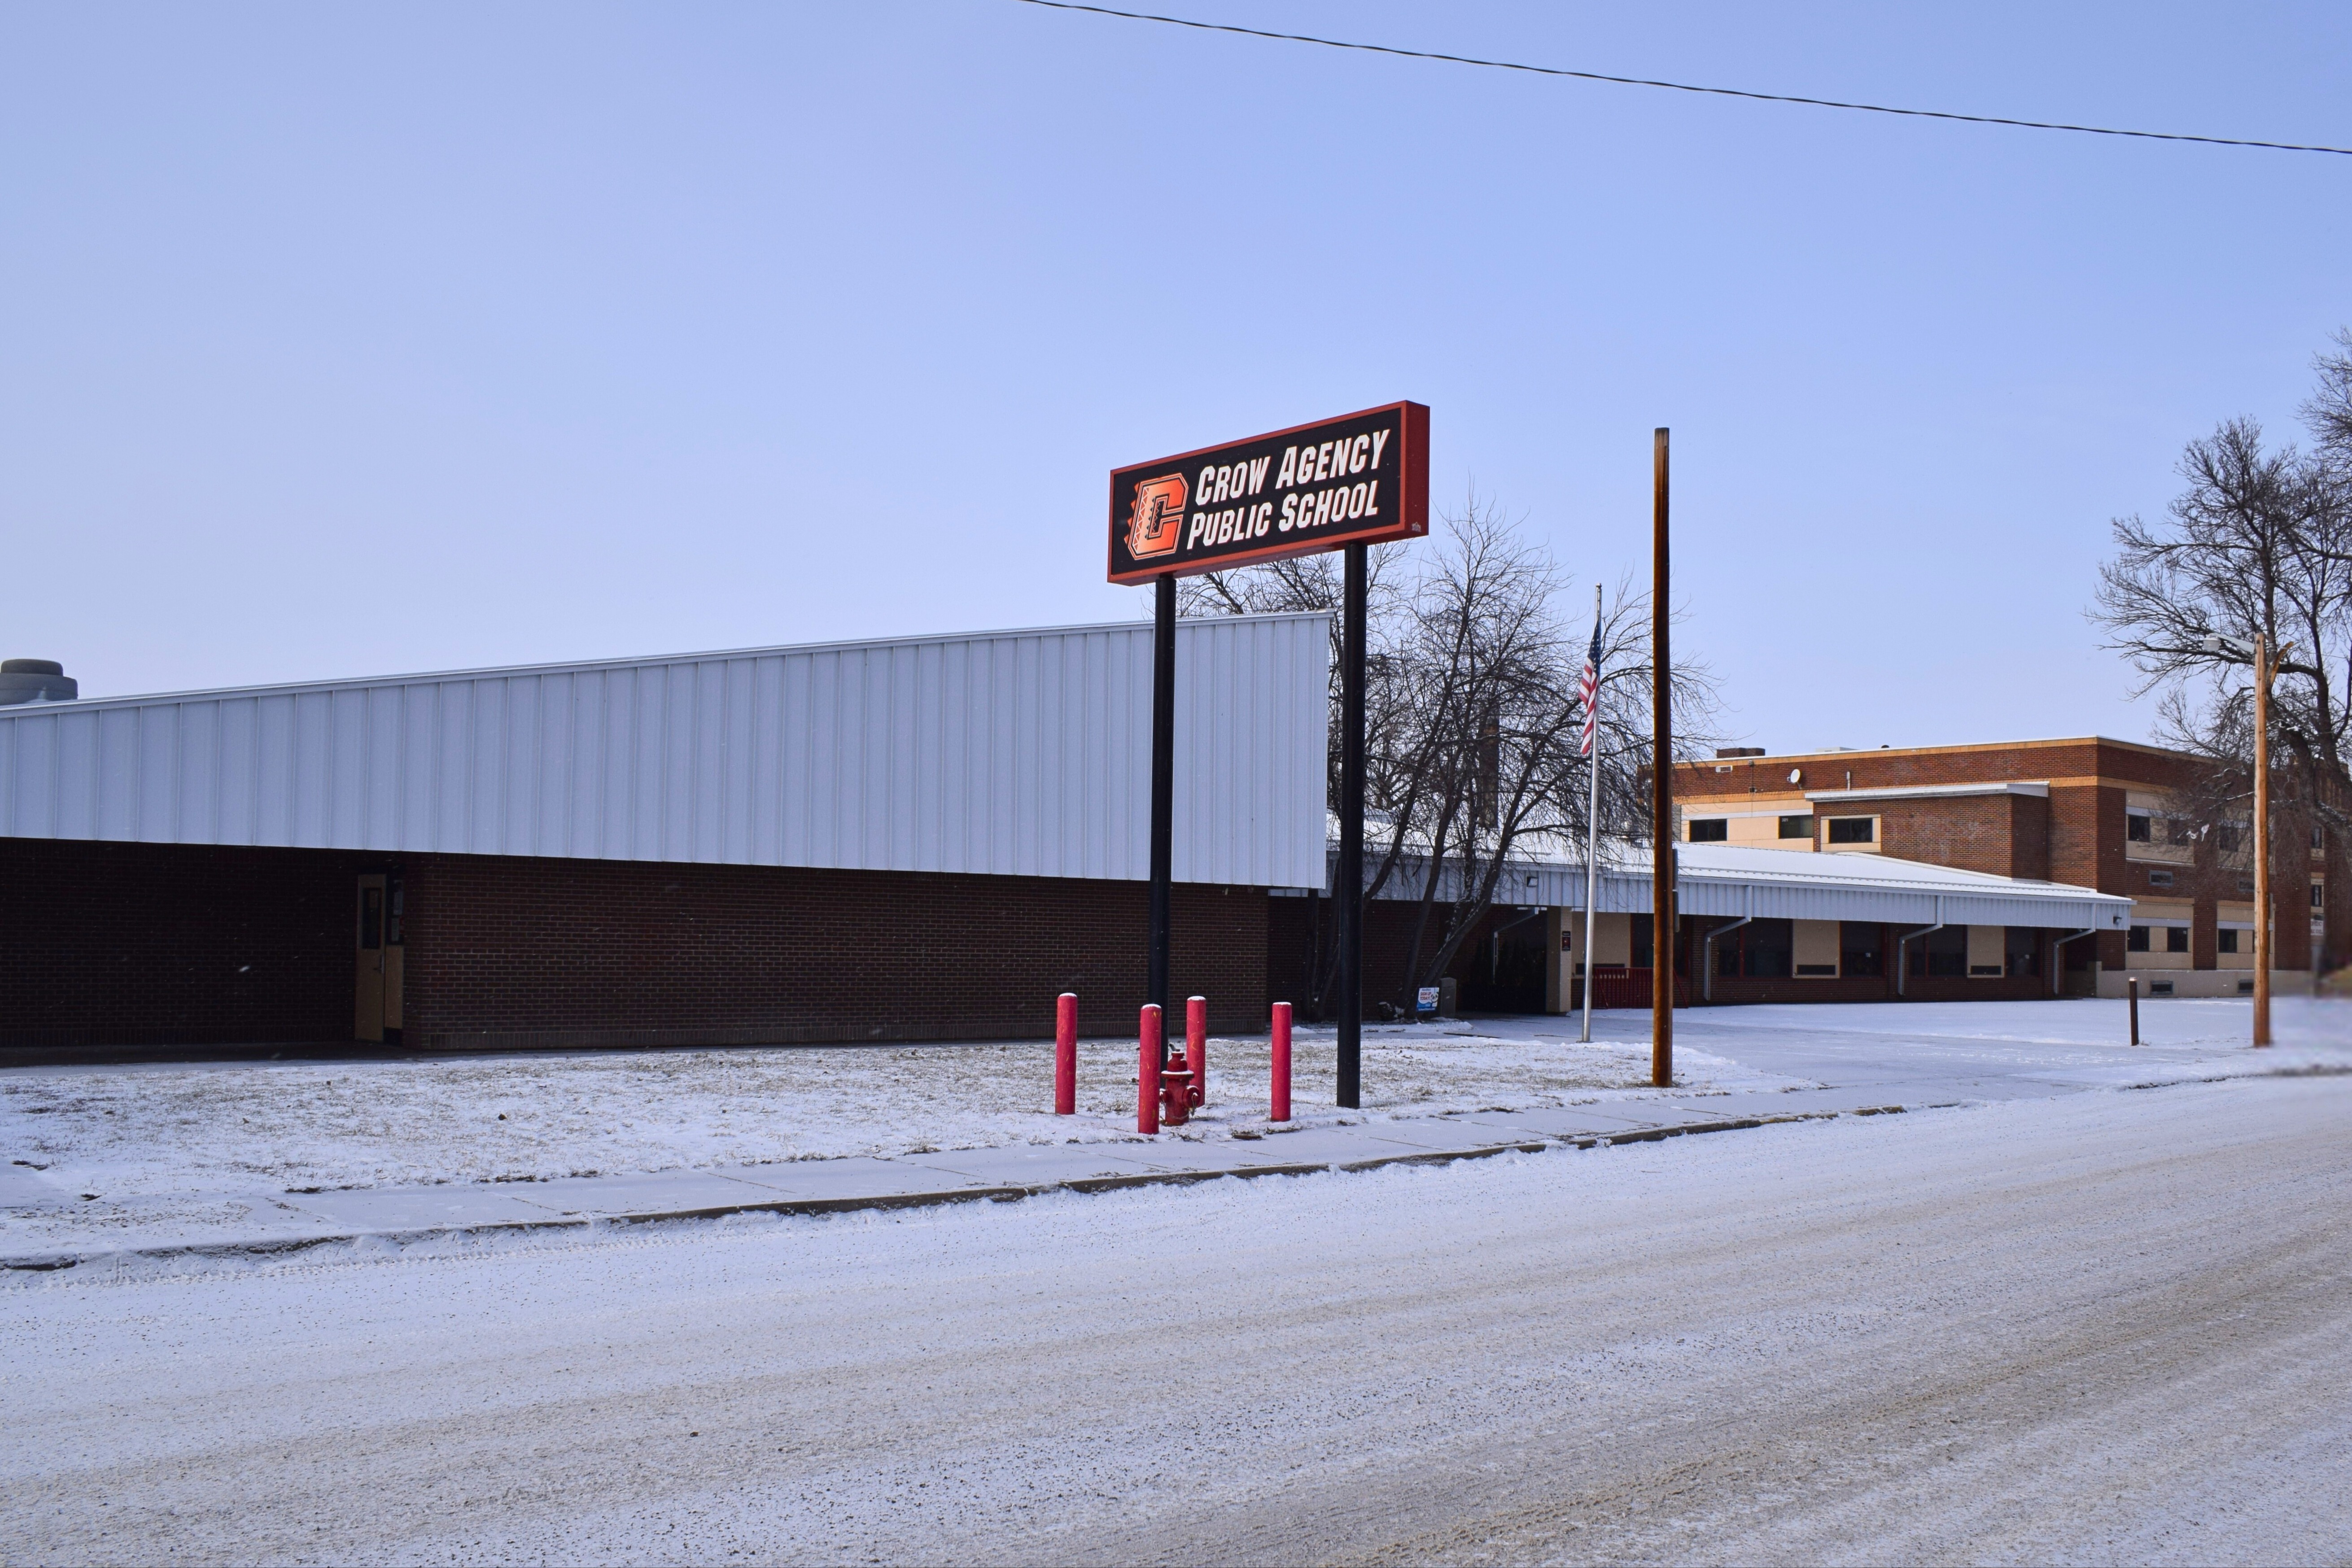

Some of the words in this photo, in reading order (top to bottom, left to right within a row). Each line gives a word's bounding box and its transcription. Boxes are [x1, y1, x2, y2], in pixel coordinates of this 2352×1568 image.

[1195, 456, 1271, 506] CROW
[1275, 429, 1390, 489] AGENCY
[1128, 472, 1189, 560] C
[1187, 502, 1273, 550] PUBLIC
[1278, 480, 1379, 532] SCHOOL
